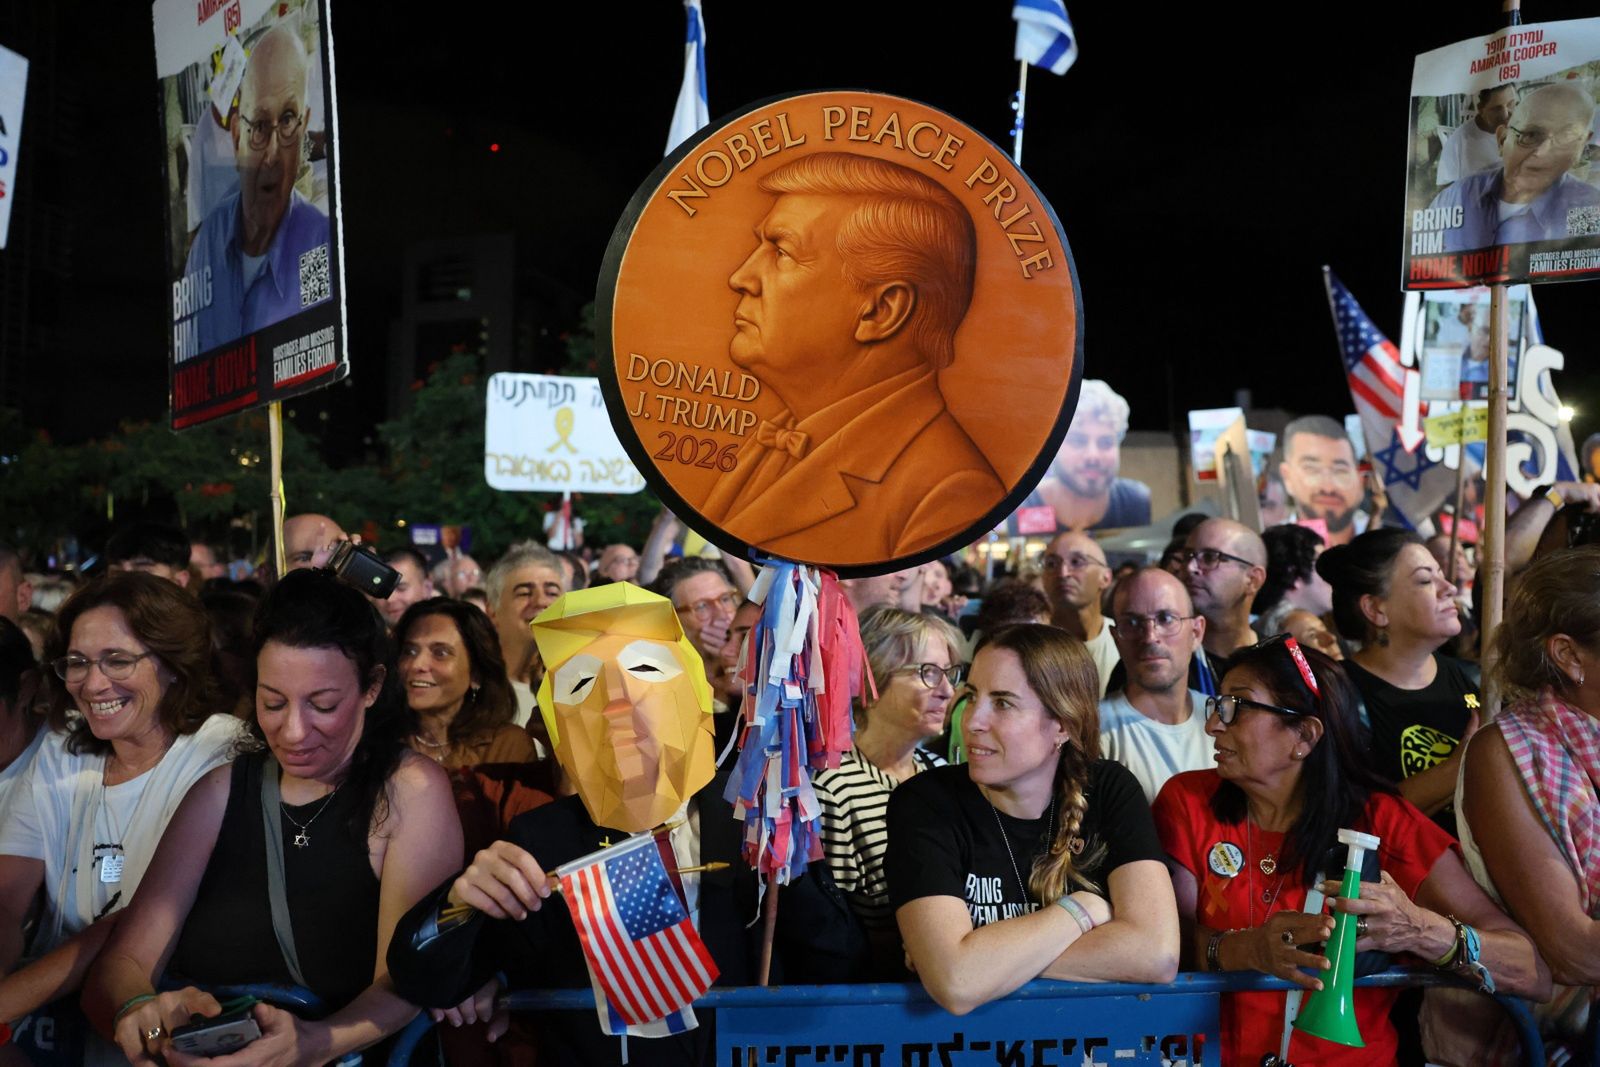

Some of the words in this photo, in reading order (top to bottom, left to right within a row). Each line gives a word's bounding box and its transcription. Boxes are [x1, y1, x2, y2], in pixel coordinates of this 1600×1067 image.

[1470, 51, 1510, 74] AMIRAM
[1513, 42, 1557, 62] COOPER
[1499, 63, 1520, 81] (85)
[667, 113, 805, 217] NOBEL
[822, 106, 965, 171] PEACE
[964, 157, 1055, 279] PRIZE
[1412, 205, 1464, 232] BRING
[1409, 255, 1457, 280] HOME
[1462, 245, 1510, 276] NOW!
[1411, 230, 1444, 256] HIM
[1560, 250, 1574, 259] AND
[1529, 259, 1568, 273] FAMILIES
[1569, 257, 1600, 270] FORUM
[172, 265, 213, 322] BRING
[173, 313, 200, 365] HIM
[175, 360, 210, 411] HOME
[215, 336, 257, 397] NOW!
[273, 352, 307, 385] FAMILIES
[307, 341, 336, 372] FORUM
[626, 353, 760, 402] DONALD
[630, 391, 651, 421] J.
[656, 394, 758, 438] TRUMP
[654, 431, 739, 473] 2026
